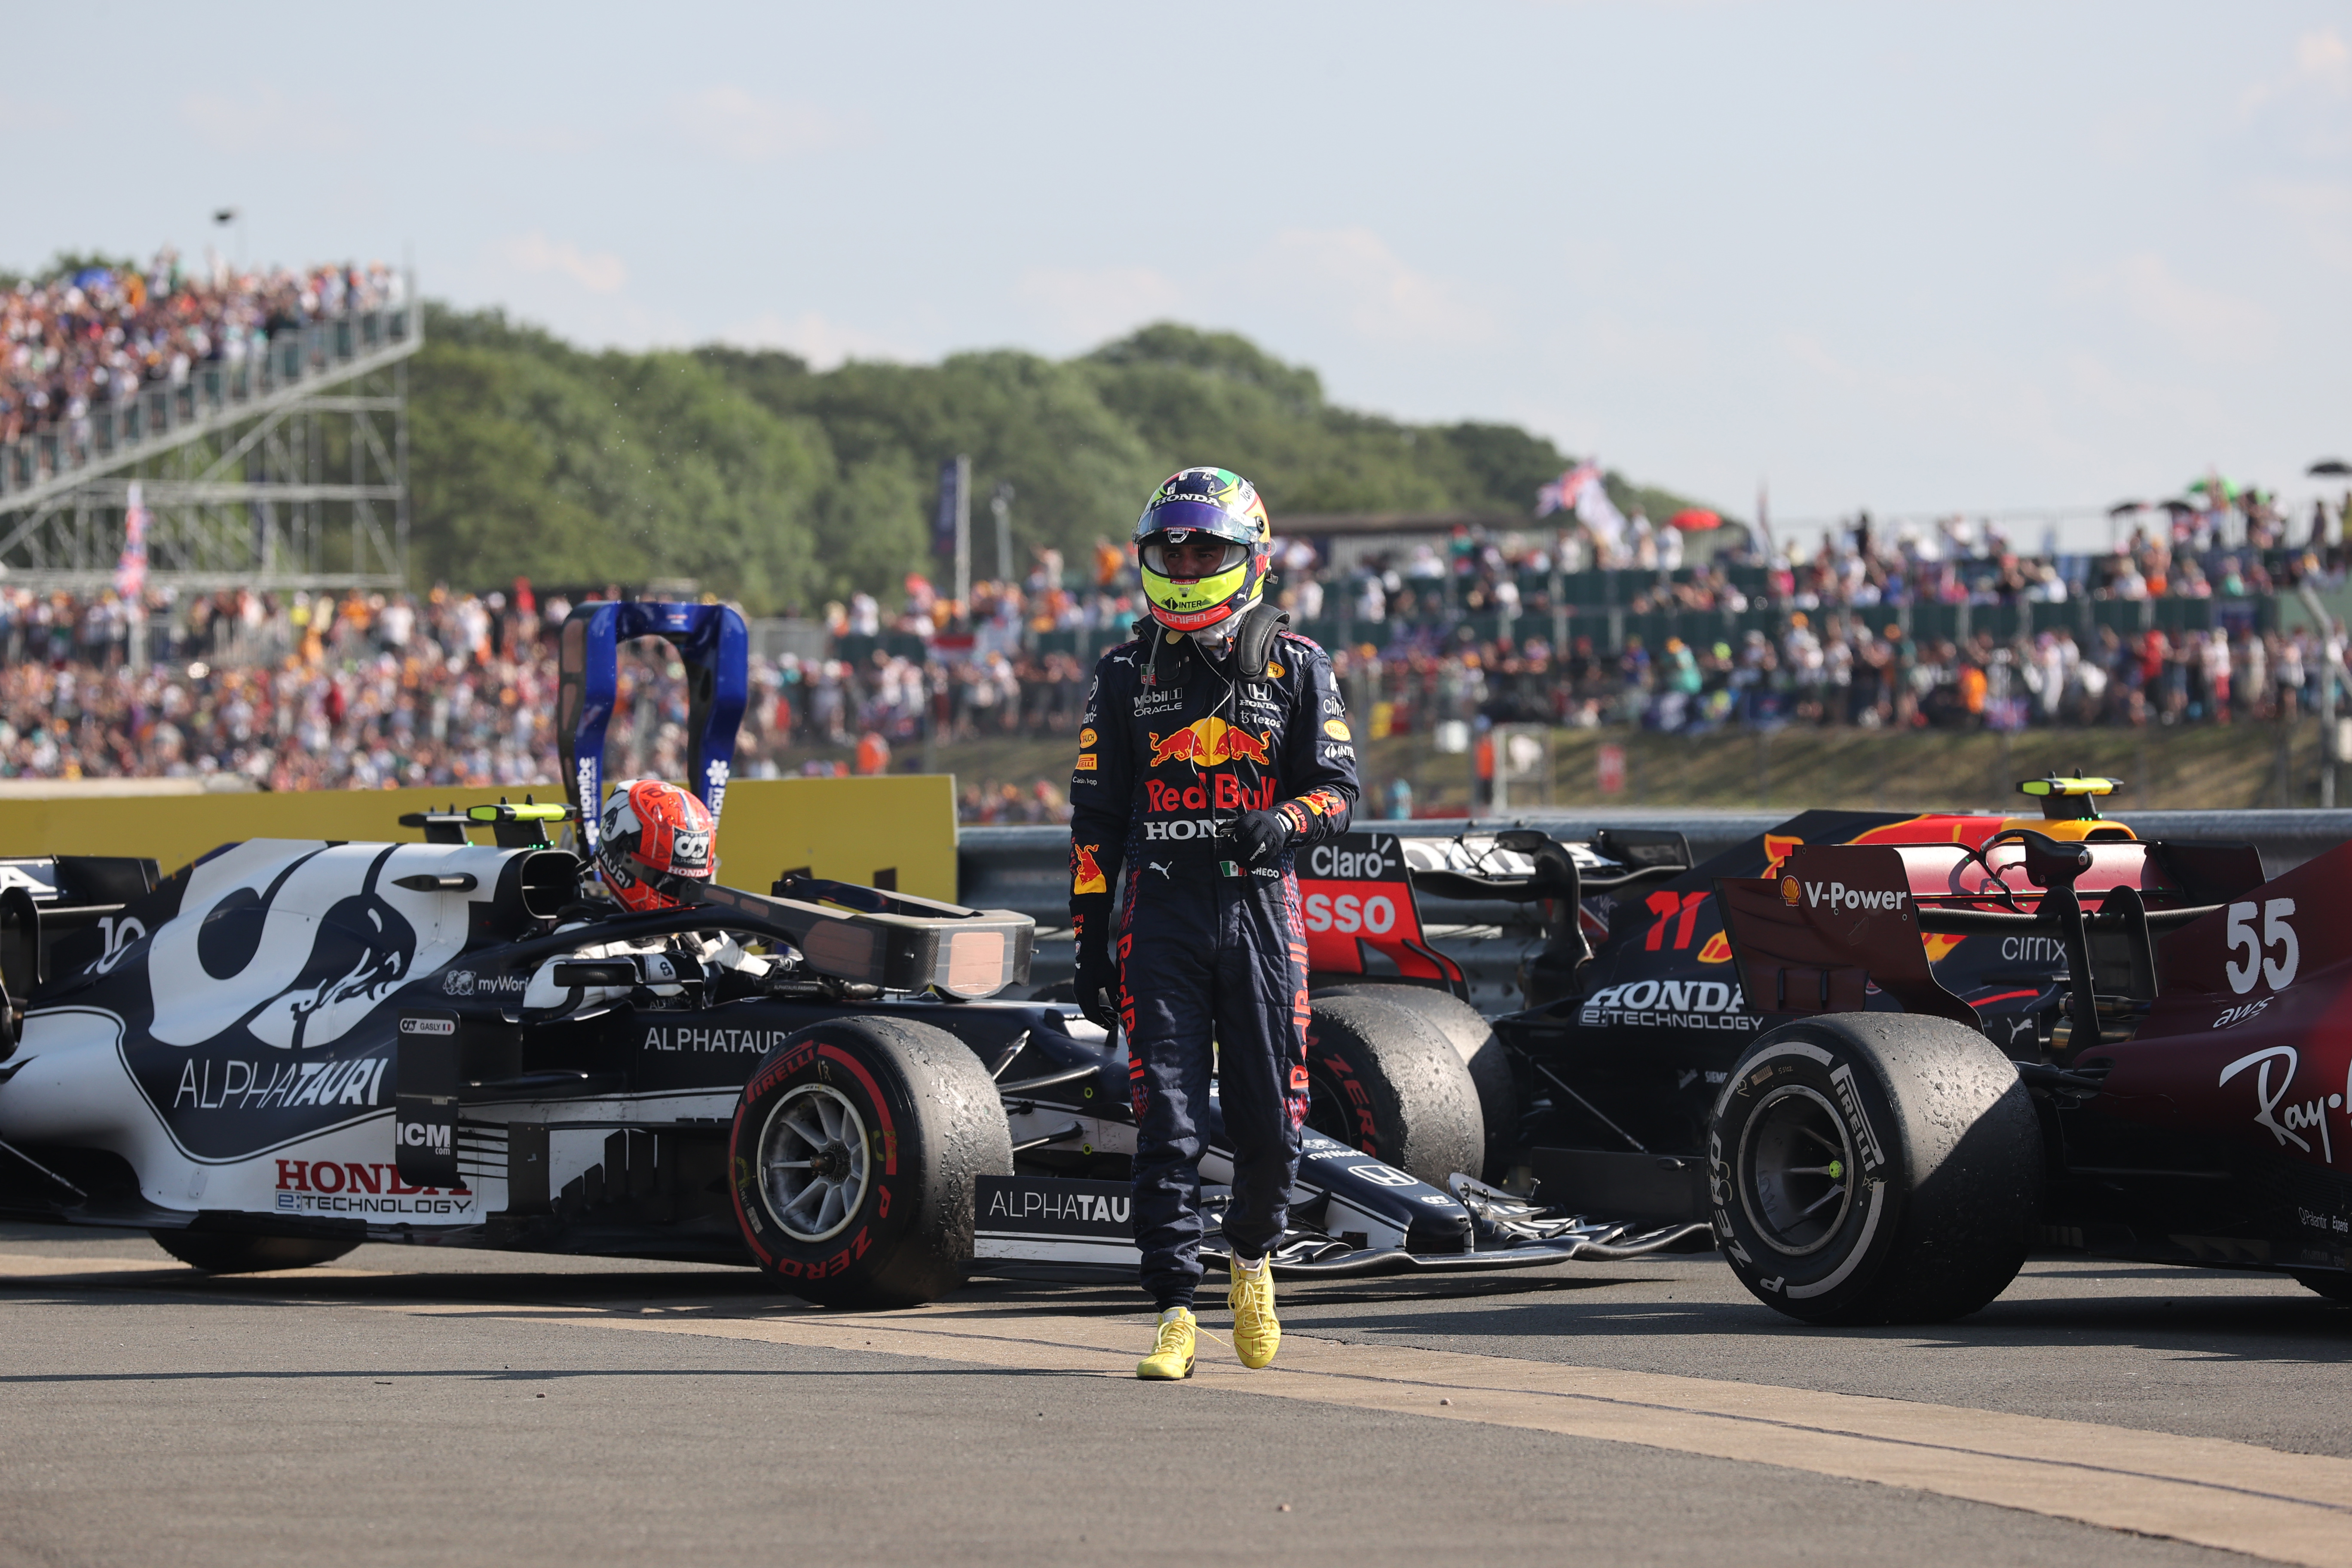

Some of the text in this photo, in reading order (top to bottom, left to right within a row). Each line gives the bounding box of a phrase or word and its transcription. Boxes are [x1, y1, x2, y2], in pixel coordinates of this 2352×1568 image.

[1154, 493, 1221, 508] HONDA
[1179, 600, 1202, 609] INTER
[1133, 691, 1167, 708] Mobil
[1134, 702, 1182, 717] ORACLE
[1239, 699, 1281, 712] HONDA
[1253, 714, 1281, 728] Tezos
[1083, 733, 1095, 744] AUCH
[1072, 776, 1086, 784] Cash
[1145, 772, 1277, 813] Red Bull
[1144, 818, 1239, 840] HON
[668, 866, 709, 877] HONDA
[1311, 845, 1383, 878] Claro
[1805, 881, 1907, 910] V-Power
[1302, 894, 1396, 934] sso
[1645, 891, 1711, 951] 11
[83, 916, 146, 975] 10
[2001, 936, 2066, 962] citrix
[2226, 897, 2300, 994] 55
[2213, 996, 2274, 1028] aws
[420, 1022, 441, 1032] GASLY
[644, 1027, 790, 1054] ALPHATAUR
[173, 1058, 389, 1109] ALPHATAURI
[744, 1038, 815, 1105] PIRELLI
[1829, 1063, 1886, 1172] PIRELLI
[276, 1159, 472, 1195] HON
[989, 1190, 1130, 1223] ALPHATAU
[1709, 1130, 1752, 1268] ZERO
[778, 1184, 891, 1280] P ZERO
[2304, 1210, 2348, 1233] Palantir Experis
[1760, 1276, 1785, 1293] P
